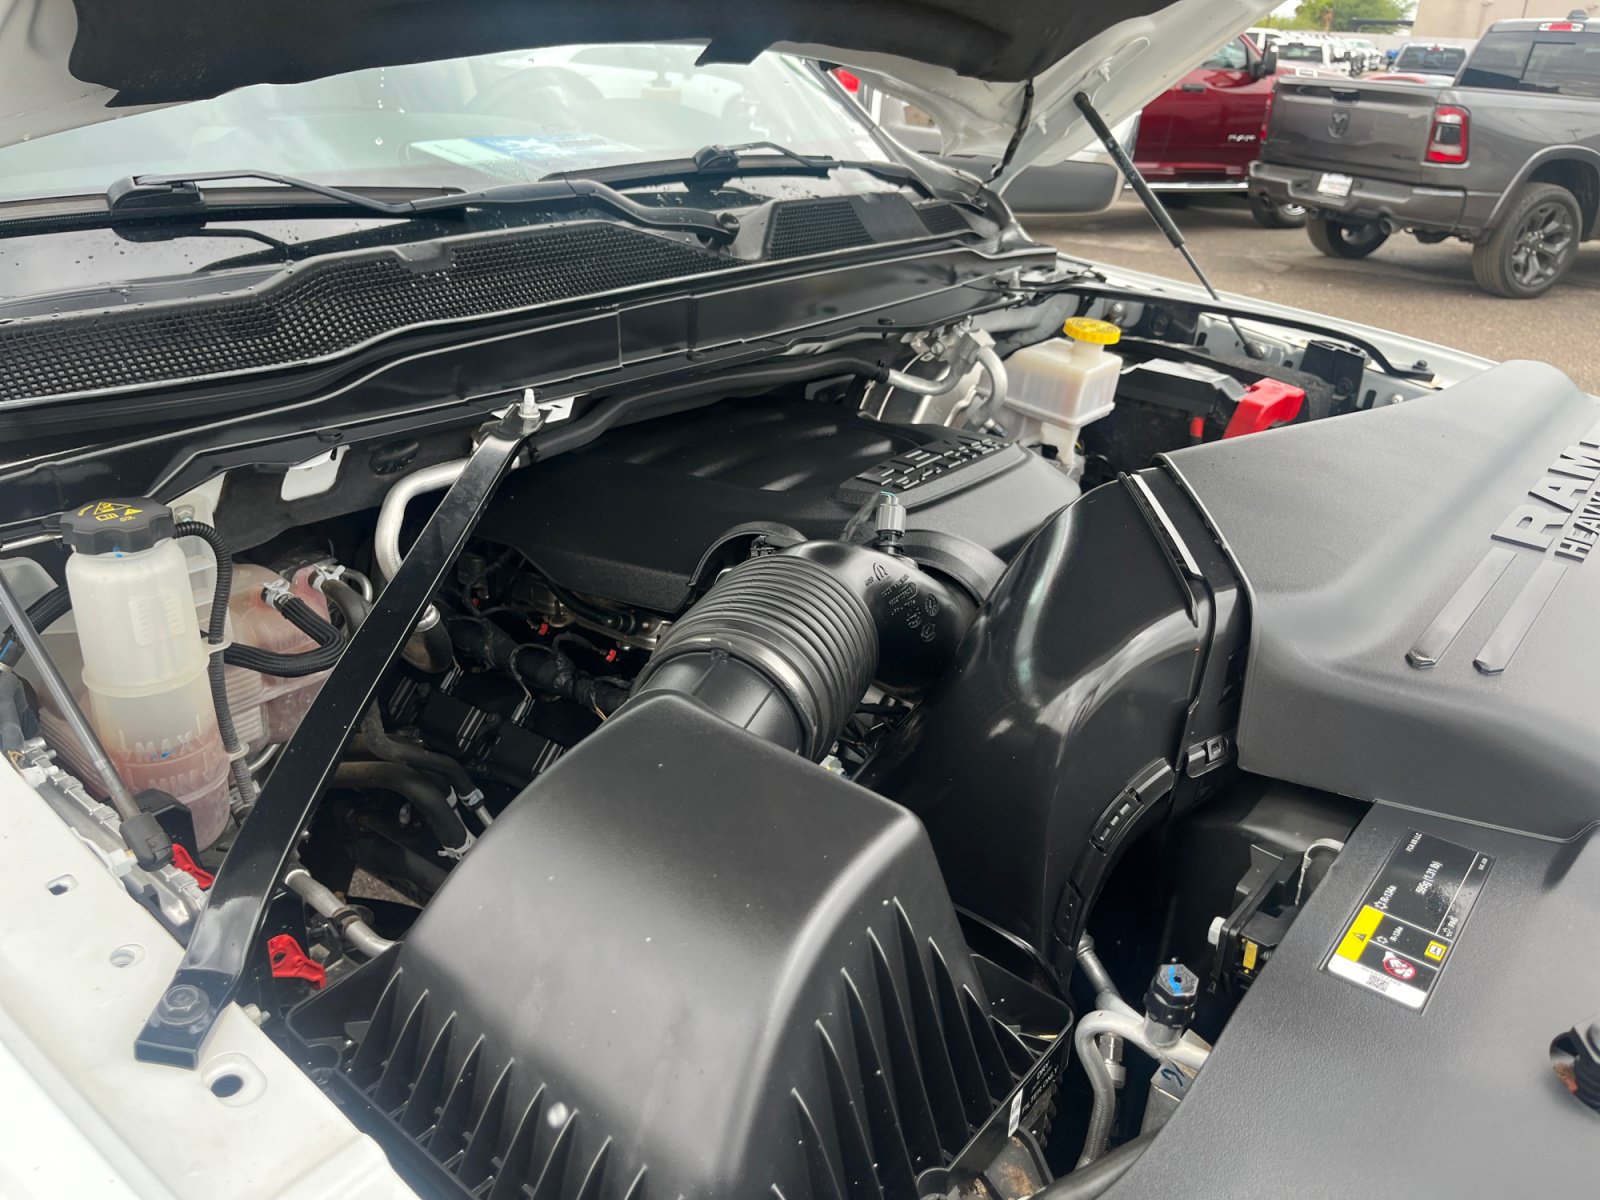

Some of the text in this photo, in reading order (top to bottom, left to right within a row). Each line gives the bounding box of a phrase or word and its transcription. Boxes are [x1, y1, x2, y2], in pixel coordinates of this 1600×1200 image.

[856, 435, 992, 486] HEMI
[1491, 445, 1600, 552] RAM
[135, 730, 193, 764] MAX
[149, 769, 200, 797] MIN
[1380, 885, 1397, 904] R-134a
[1036, 1060, 1050, 1080] DRY
[1042, 1065, 1059, 1088] ONLY
